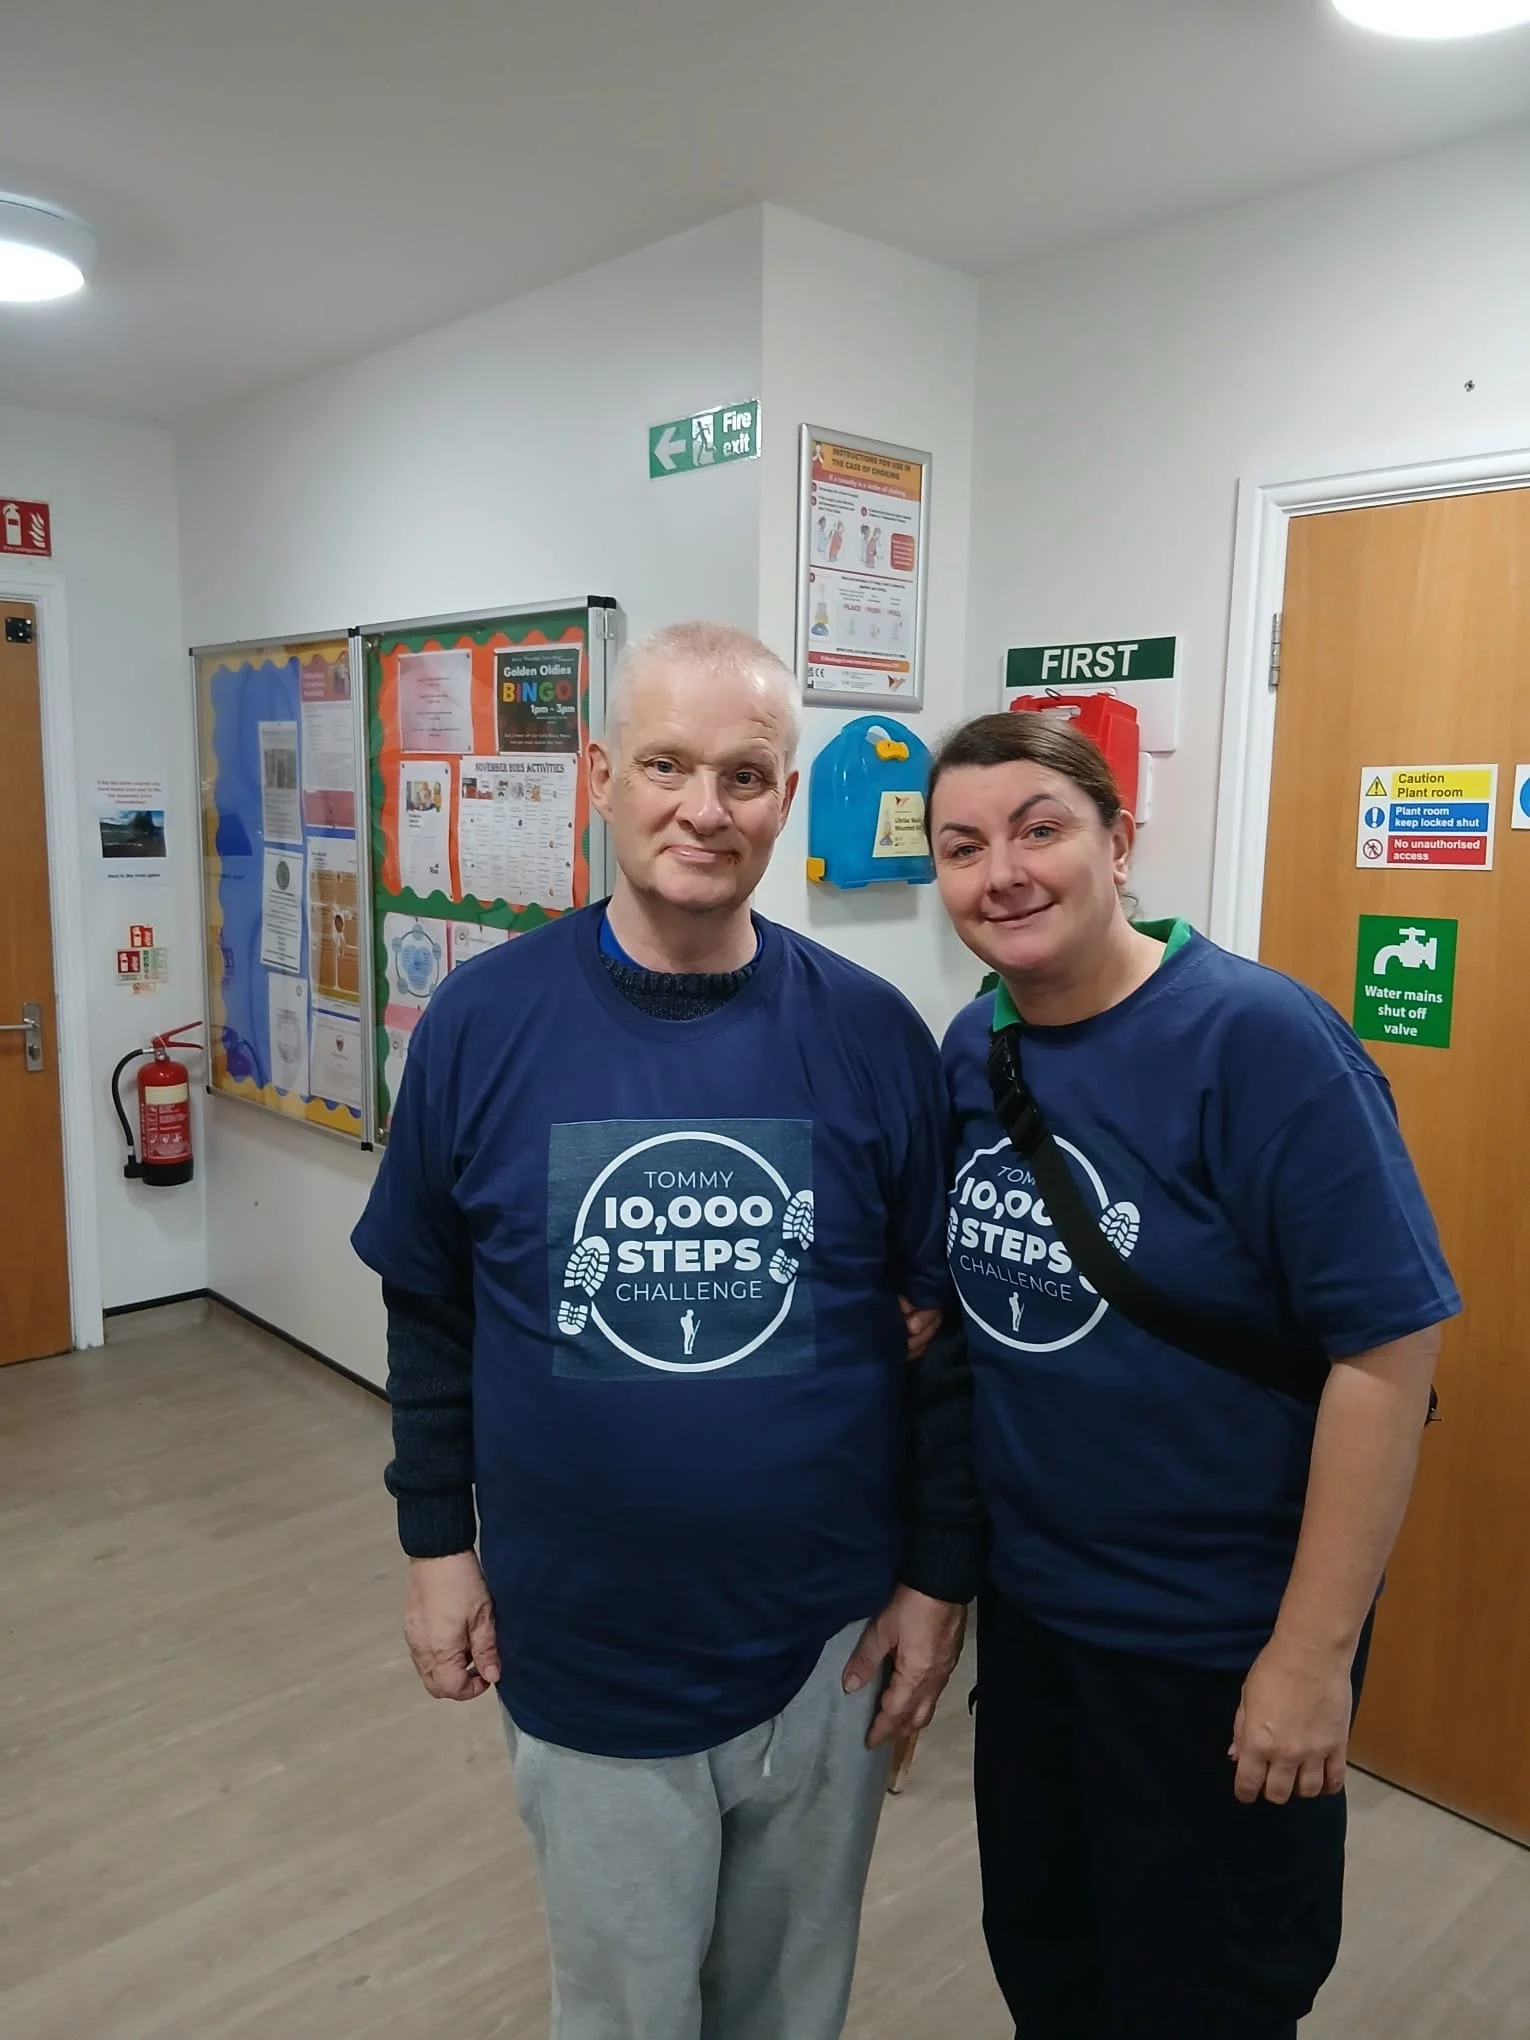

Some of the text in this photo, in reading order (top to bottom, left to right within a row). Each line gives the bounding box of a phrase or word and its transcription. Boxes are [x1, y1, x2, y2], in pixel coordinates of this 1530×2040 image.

[723, 411, 752, 433] Fire
[723, 433, 750, 457] exit
[832, 448, 877, 464] INSTRUCTIONS
[879, 459, 890, 467] FOR
[832, 458, 899, 480] THE CASE OF CHOKING
[503, 664, 572, 677] Golden Oldies
[1041, 643, 1139, 680] FIRST
[502, 681, 573, 702] BINGO
[530, 704, 548, 715] 1pm
[556, 704, 575, 715] 3pm
[475, 762, 507, 772] NOVEMBER
[526, 762, 565, 773] ACTIVITIES
[1398, 773, 1445, 784] Caution
[1397, 787, 1463, 797] Plant room
[1395, 806, 1449, 815] Plant room
[1395, 818, 1479, 828] keep locked shut
[1394, 839, 1480, 849] No unauthorised
[1393, 852, 1429, 860] access
[1364, 985, 1443, 1003] Water mains
[1378, 1004, 1427, 1019] shut off
[1384, 1023, 1417, 1036] valve
[644, 1171, 734, 1189] TOMMY
[997, 1165, 1037, 1186] TOM
[605, 1195, 773, 1235] 10,000
[960, 1217, 1072, 1274] STEPS
[617, 1238, 762, 1274] STEPS
[960, 1255, 1073, 1302] CHALLENGE
[616, 1280, 763, 1302] CHALLENGE
